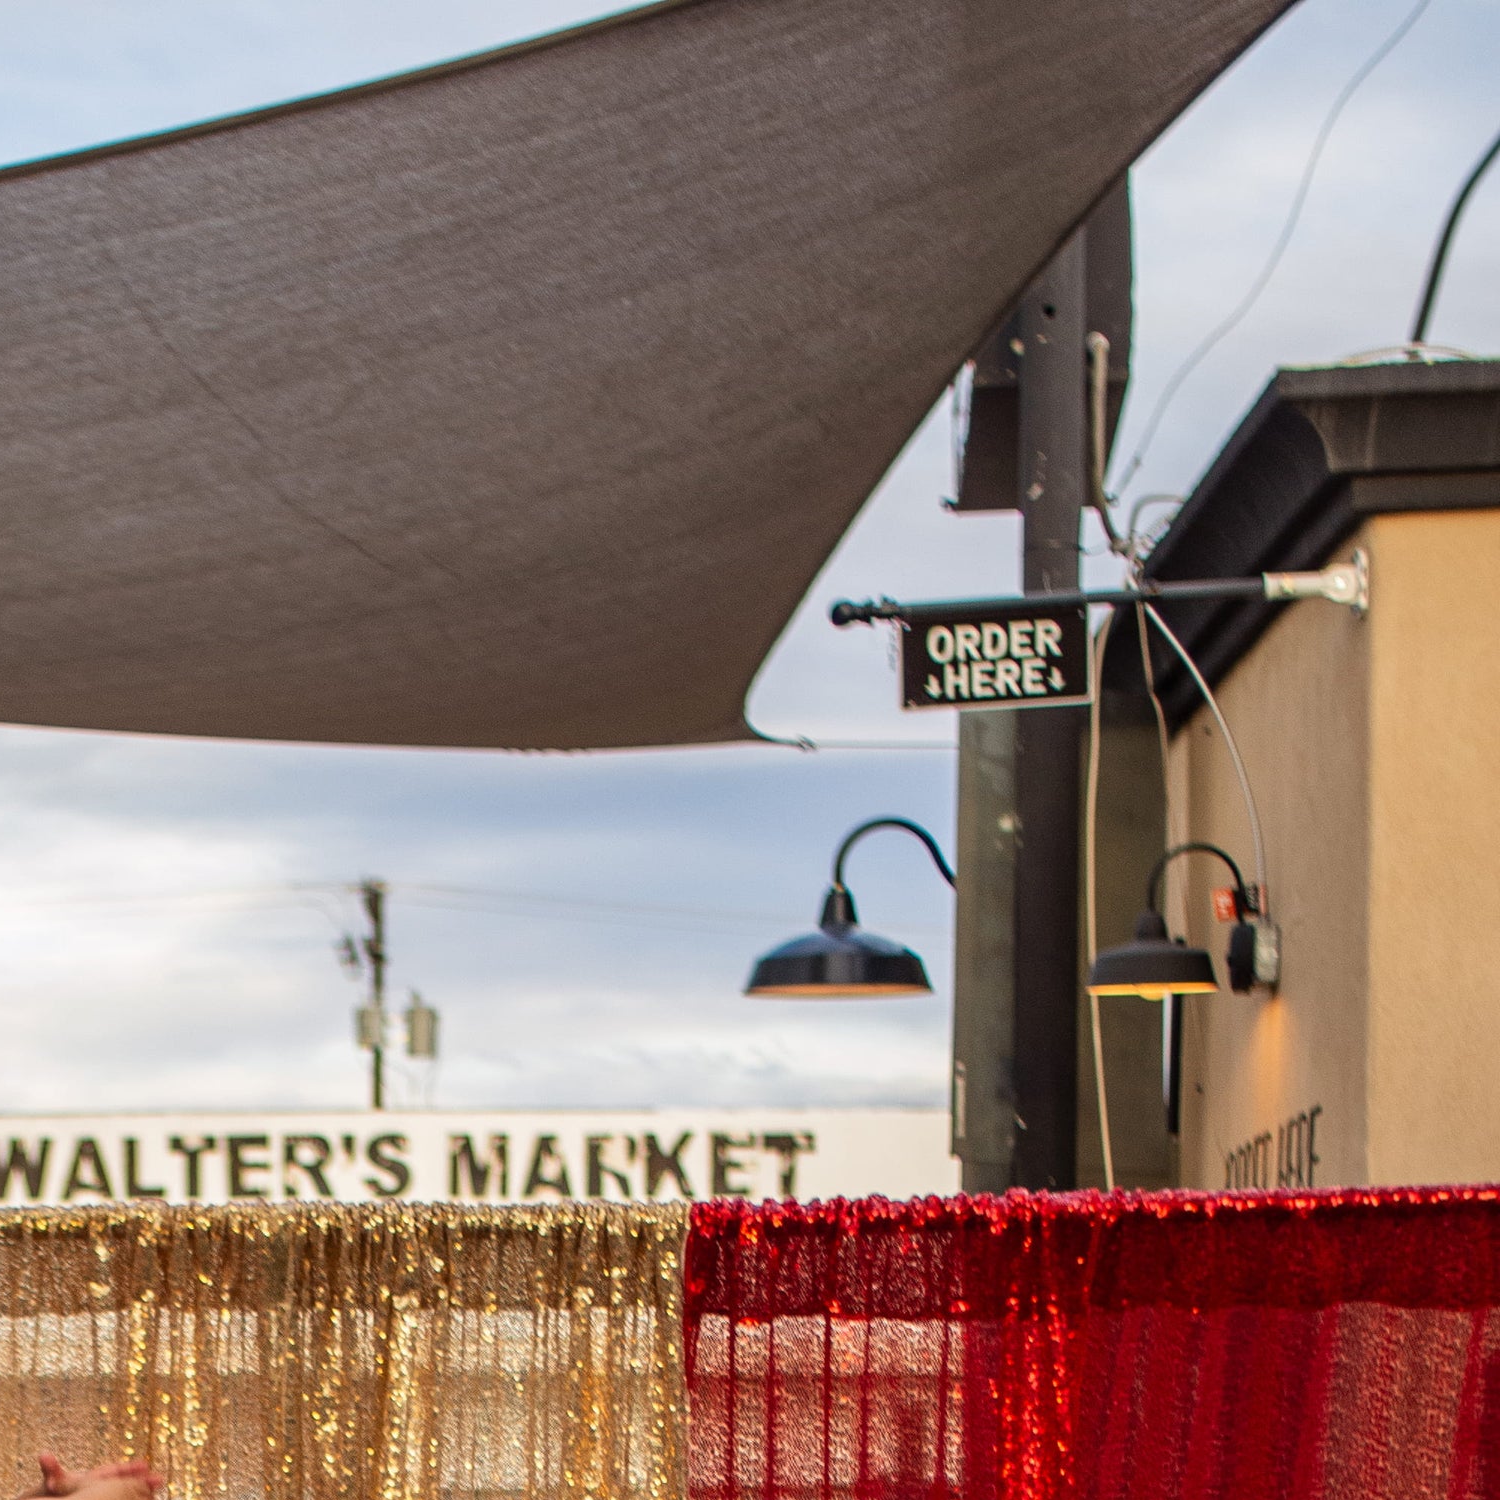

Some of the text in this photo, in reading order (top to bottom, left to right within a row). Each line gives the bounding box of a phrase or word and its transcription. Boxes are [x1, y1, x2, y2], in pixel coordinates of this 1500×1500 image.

[926, 618, 1063, 664] ORDER
[944, 657, 1048, 700] HERE
[447, 1131, 816, 1198] MARKET
